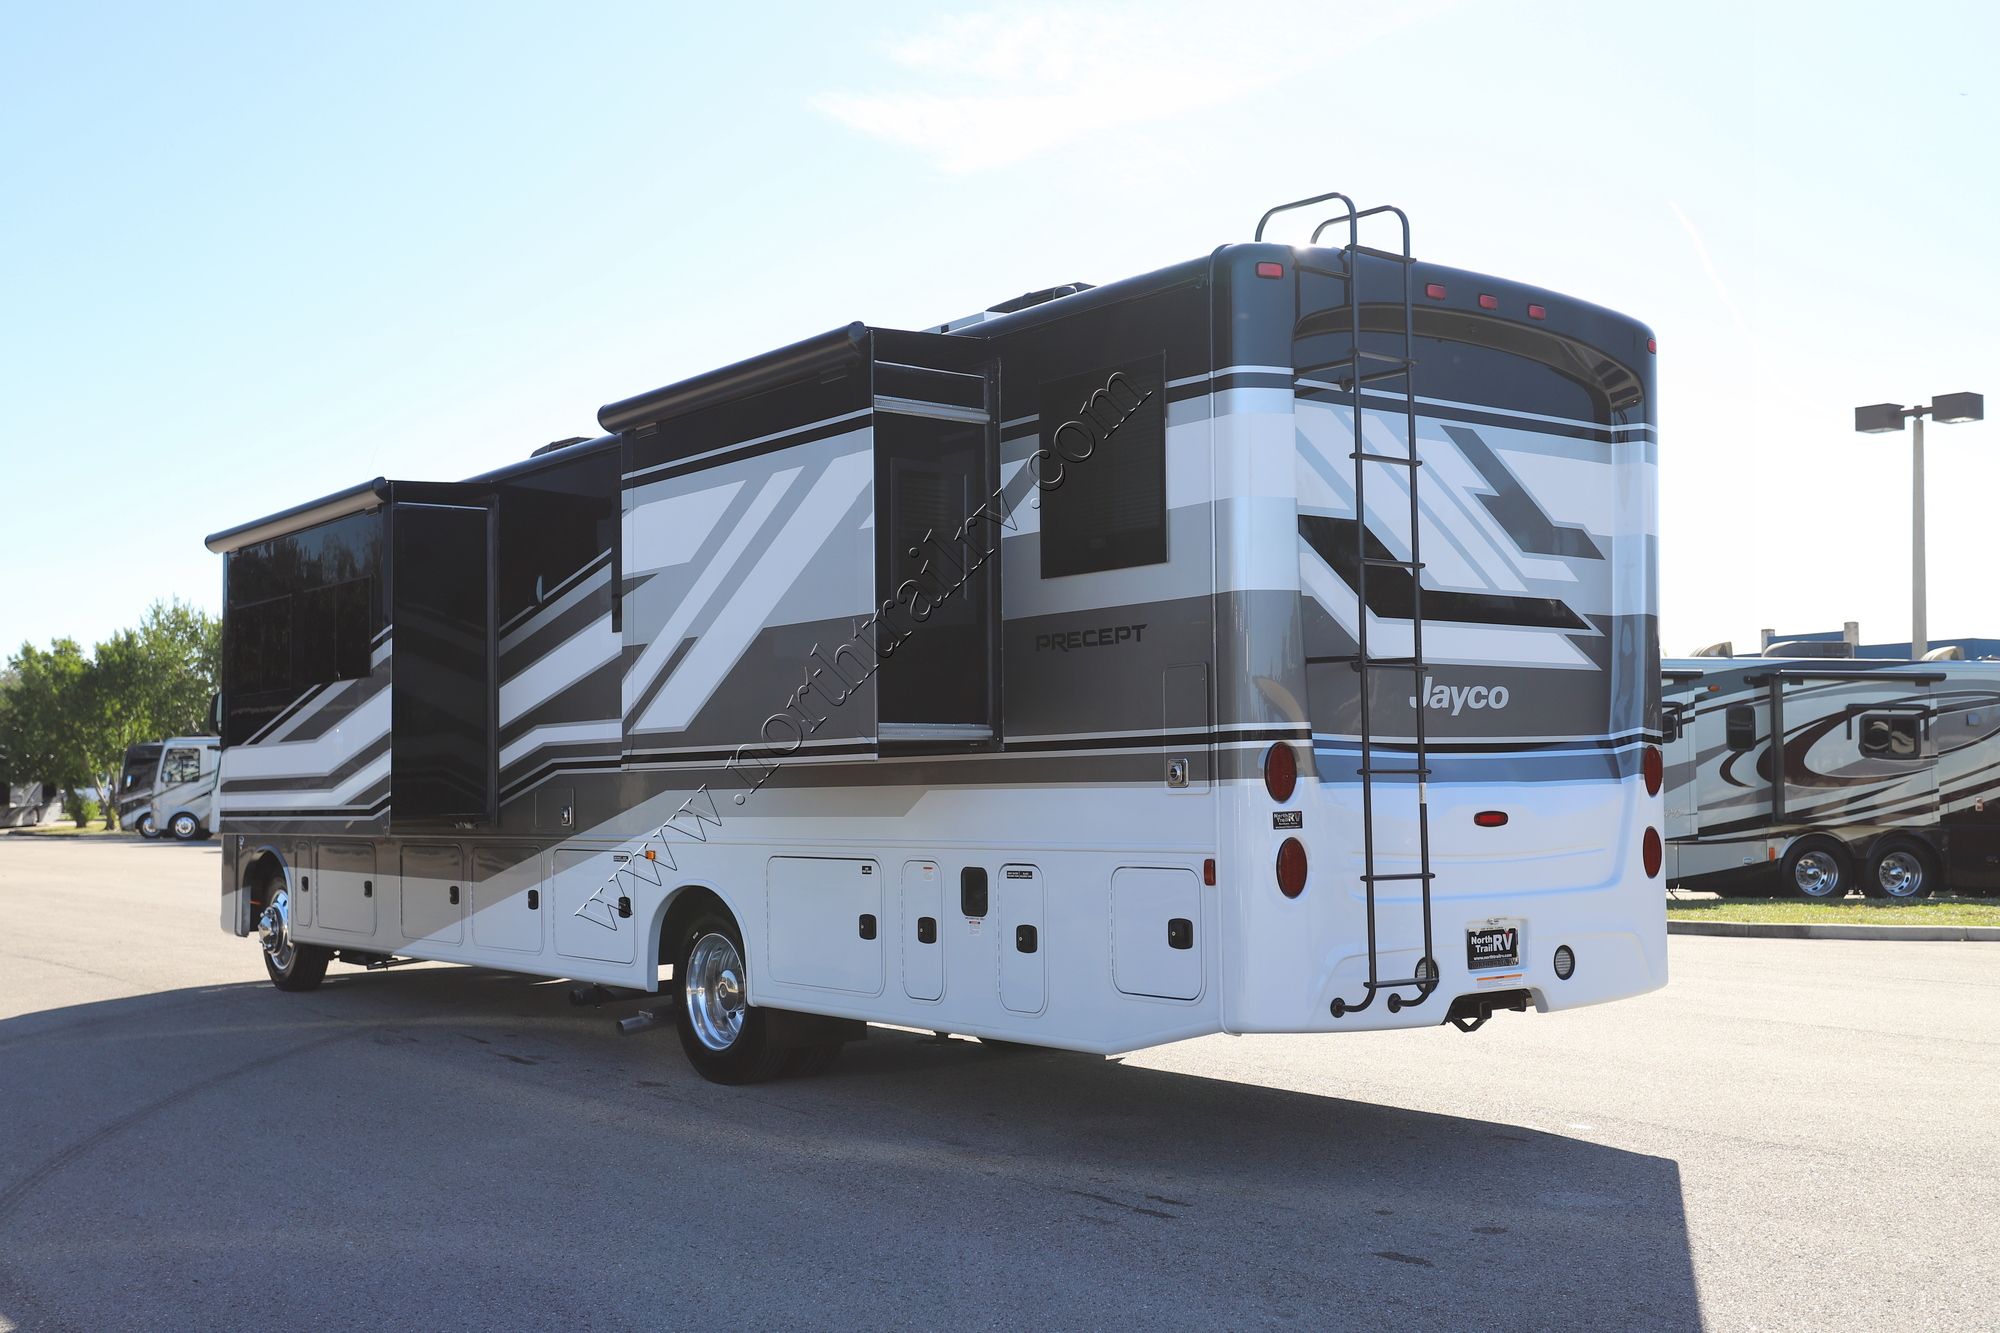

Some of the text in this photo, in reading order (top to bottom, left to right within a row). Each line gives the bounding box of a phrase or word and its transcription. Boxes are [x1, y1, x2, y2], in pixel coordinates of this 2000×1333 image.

[1035, 623, 1147, 652] PRECEPT
[1409, 676, 1509, 716] Jayco
[1471, 935, 1492, 945] North
[1475, 944, 1492, 953] Trail
[1493, 933, 1513, 951] RV
